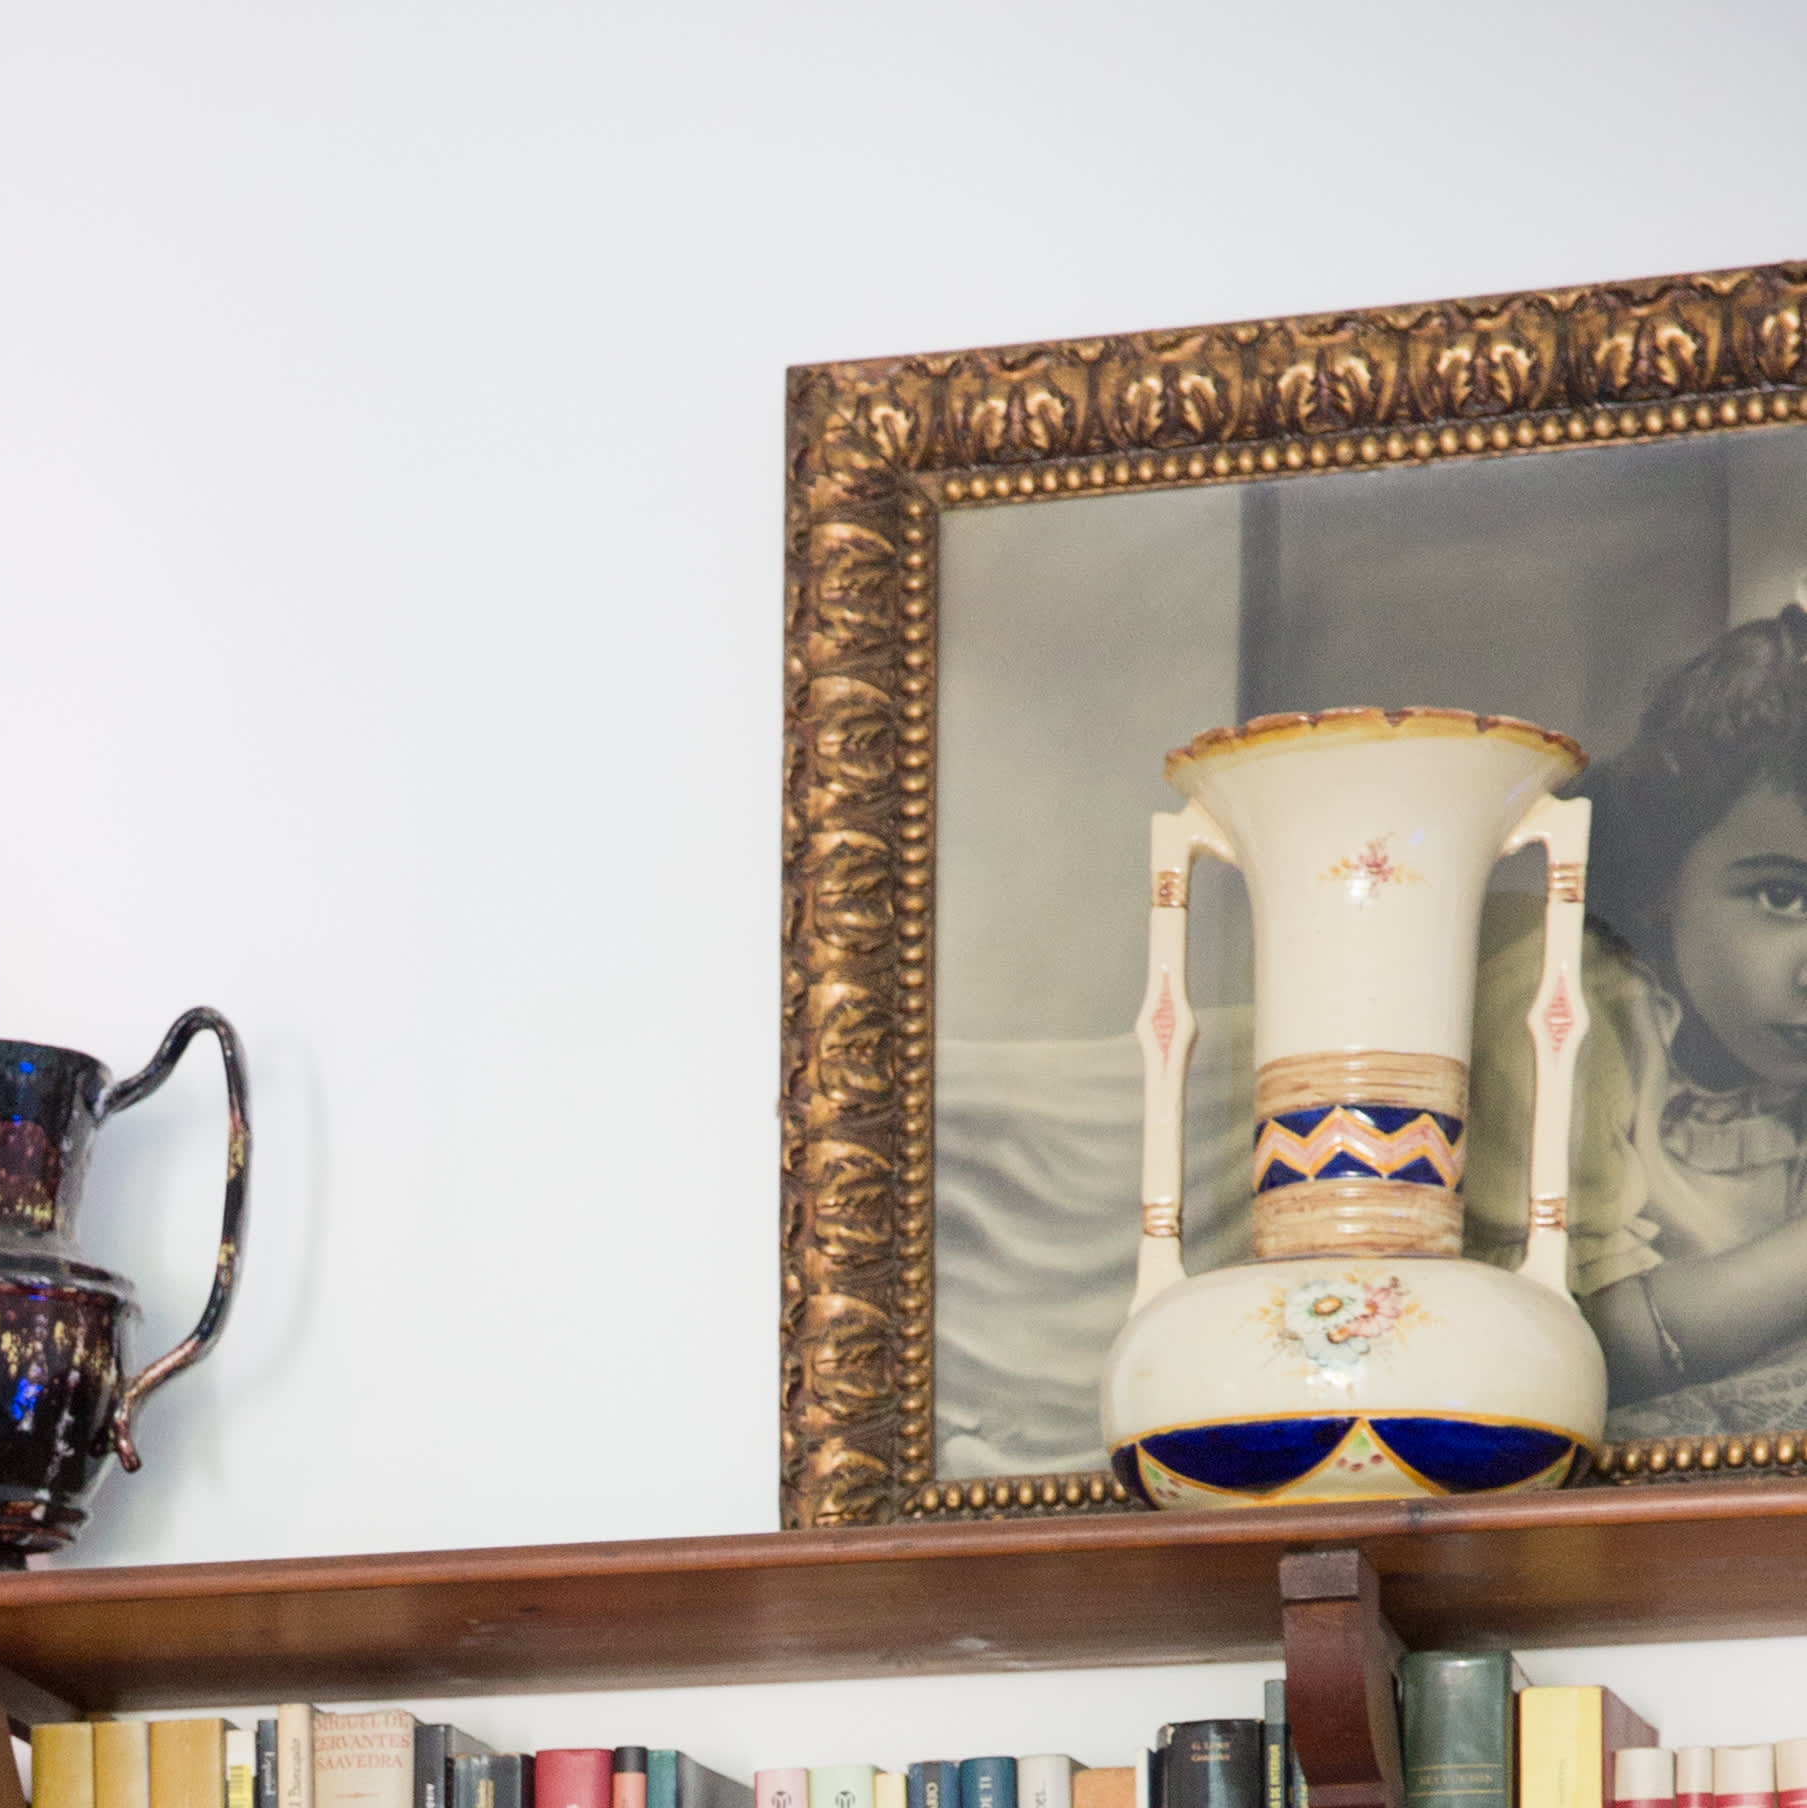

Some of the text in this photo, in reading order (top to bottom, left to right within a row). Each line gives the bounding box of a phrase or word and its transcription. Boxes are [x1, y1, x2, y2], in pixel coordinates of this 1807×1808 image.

[316, 1754, 405, 1770] SAAVEDRA
[1269, 1743, 1280, 1785] INTERIOR
[1269, 1787, 1280, 1800] DE
